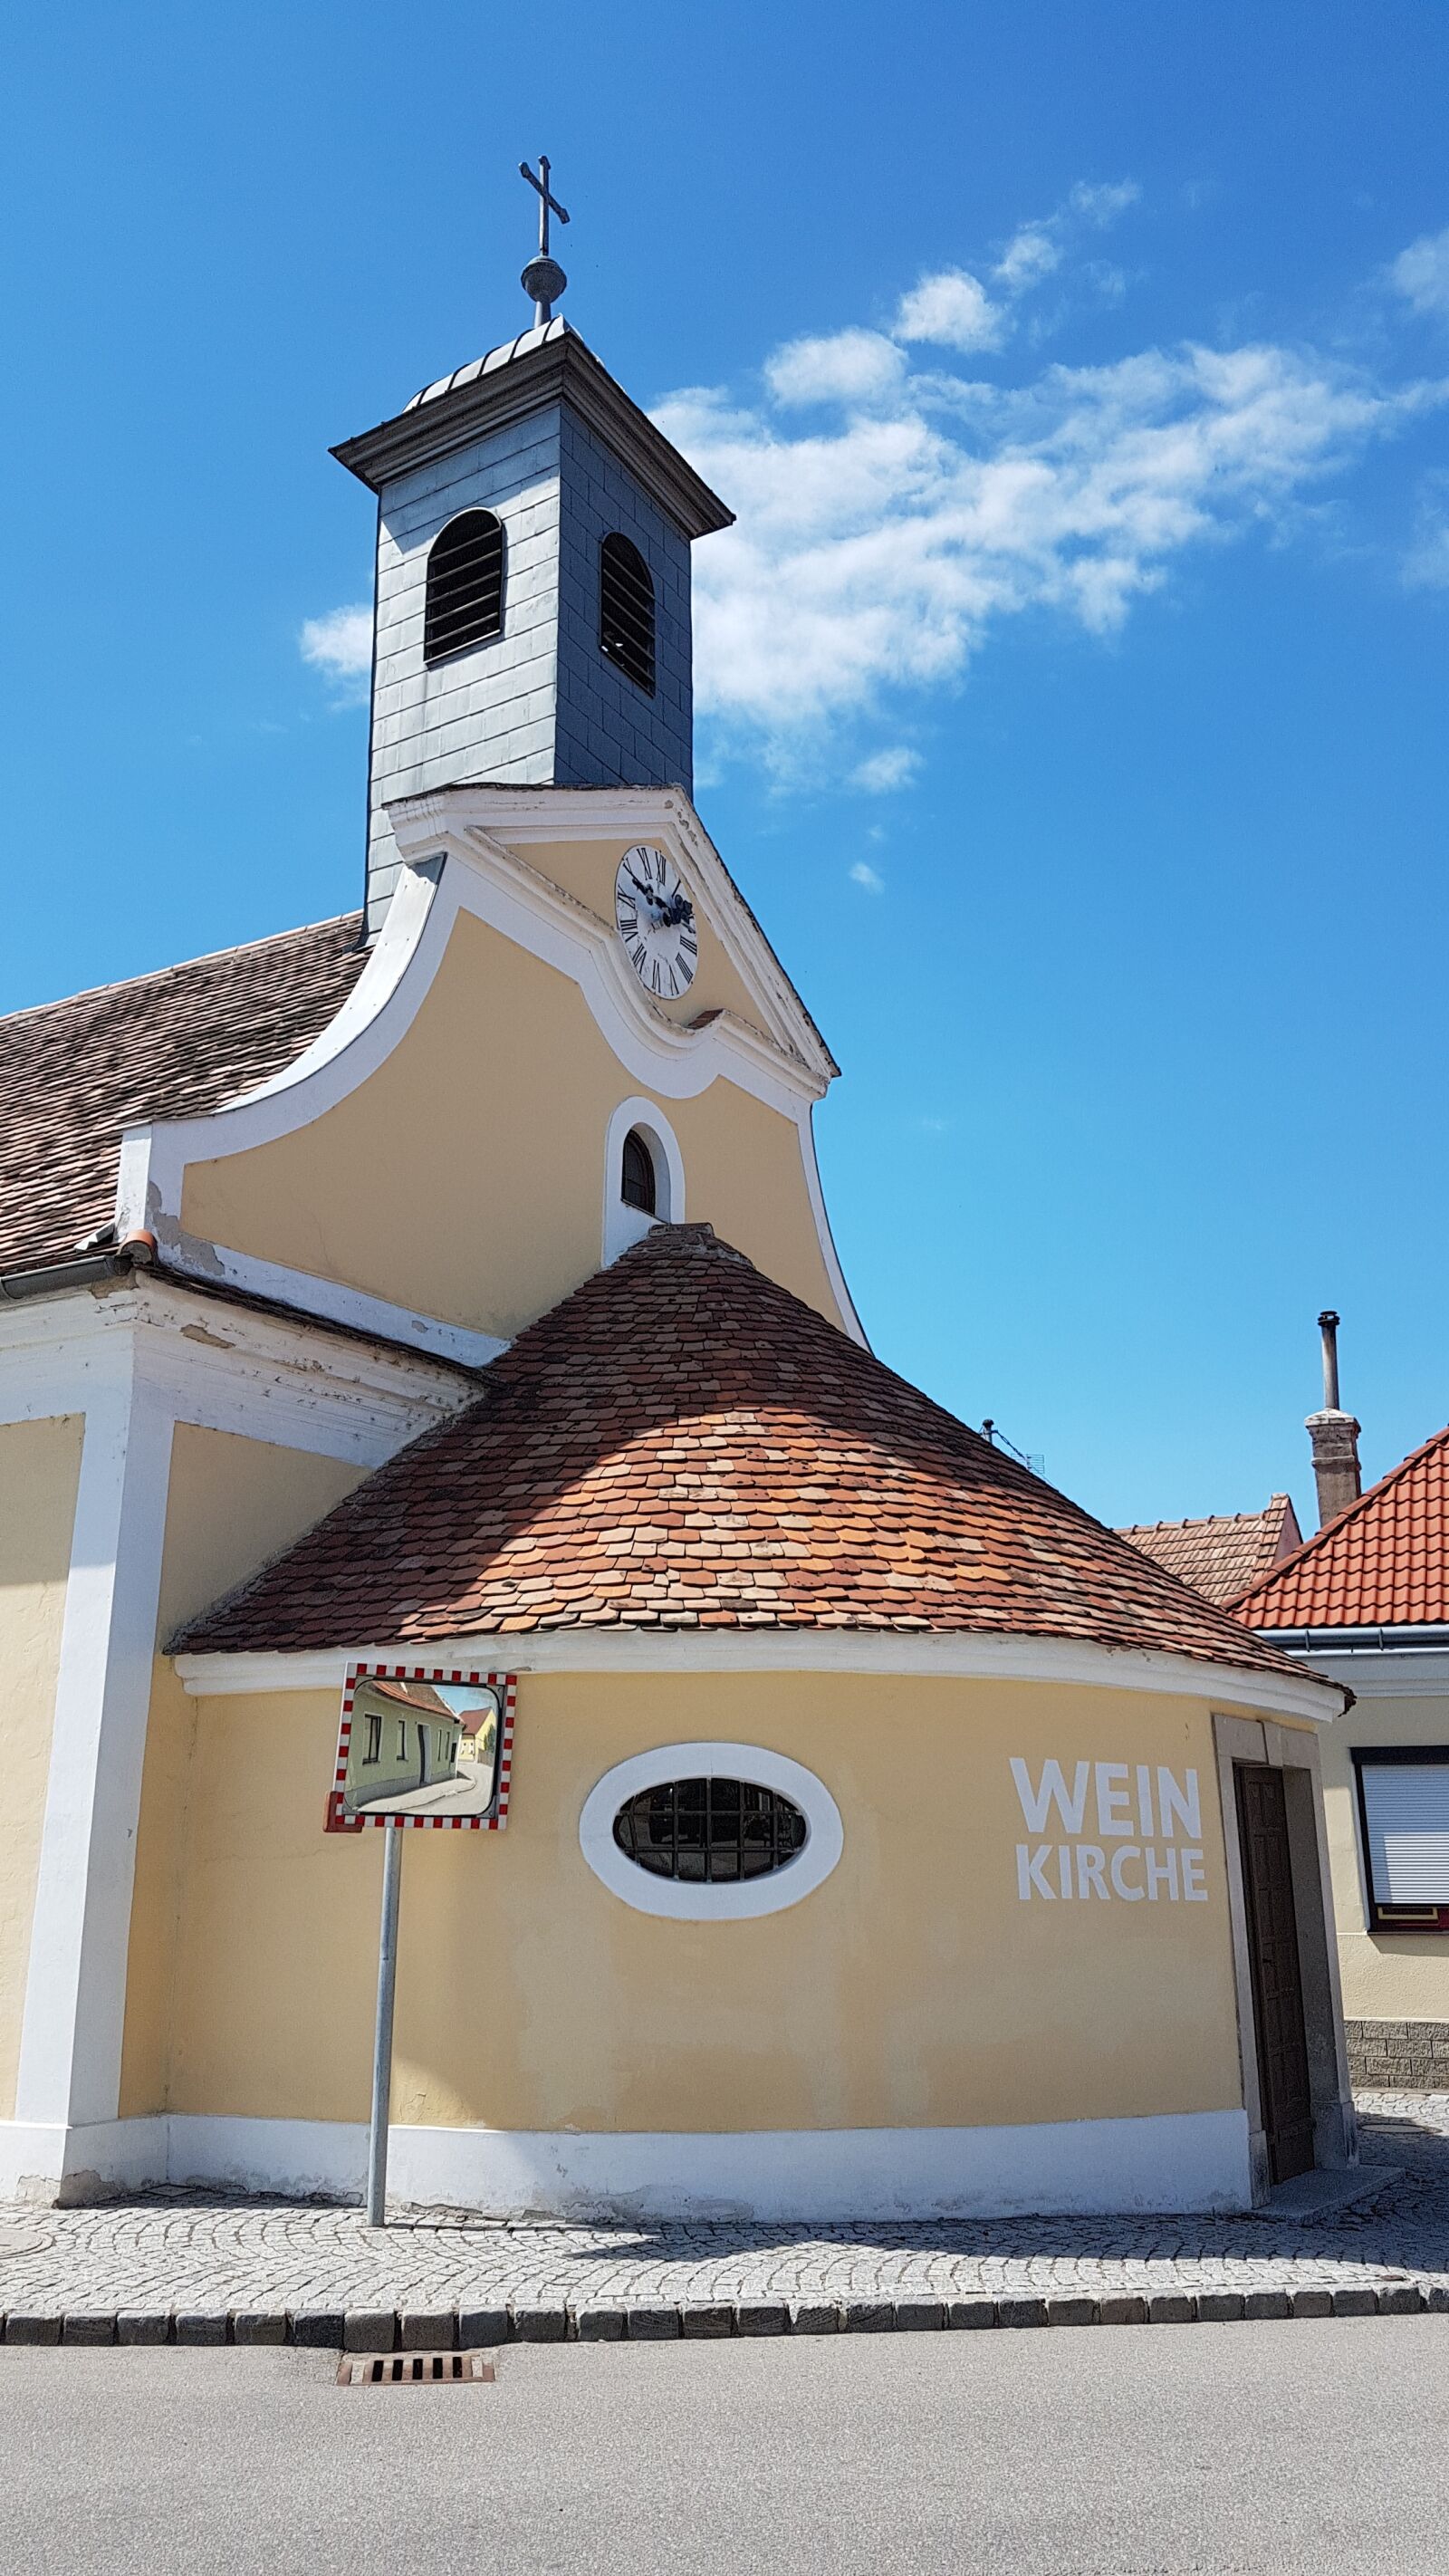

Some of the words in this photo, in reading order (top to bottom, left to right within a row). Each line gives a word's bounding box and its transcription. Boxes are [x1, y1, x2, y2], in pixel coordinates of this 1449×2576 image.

[620, 919, 638, 942] VIII
[680, 935, 697, 956] III
[652, 959, 661, 993] VI
[668, 965, 679, 995] V
[1009, 1757, 1202, 1839] WEIN
[1015, 1844, 1208, 1901] KIRCHE
